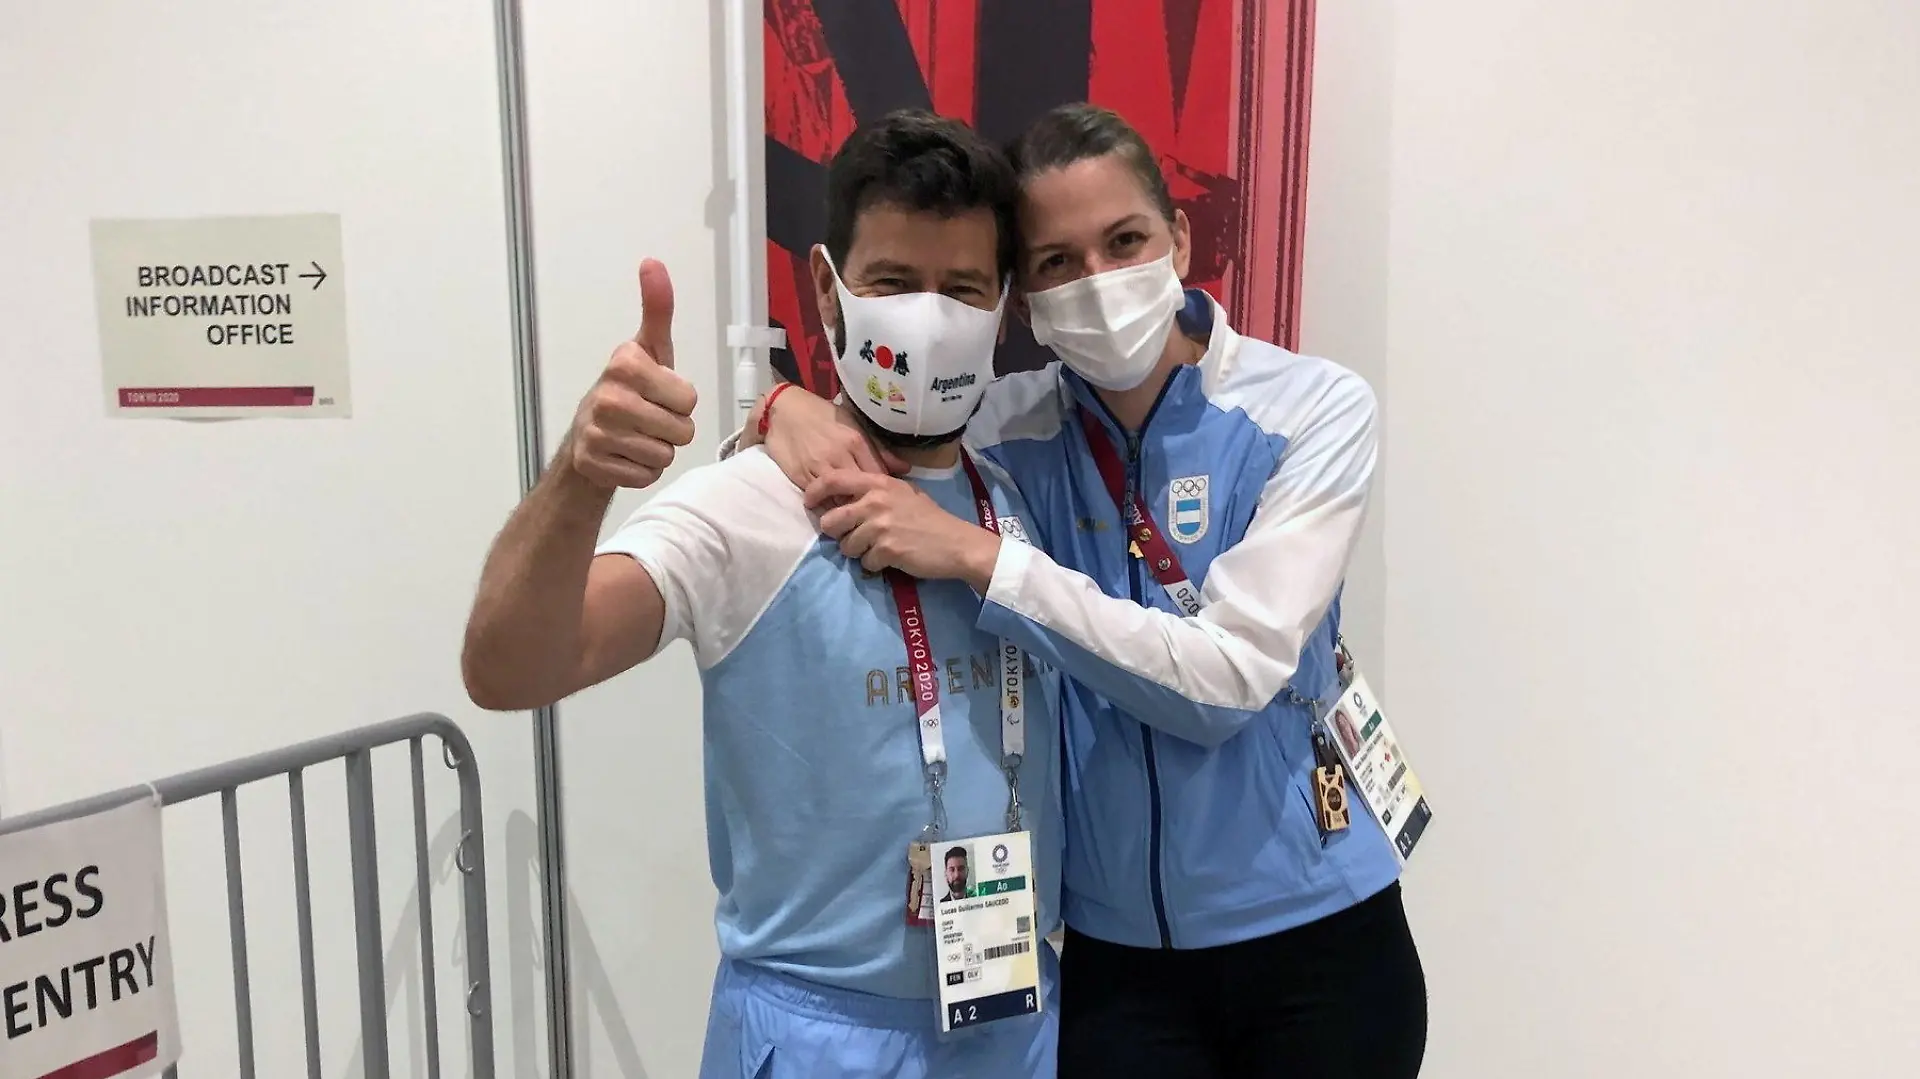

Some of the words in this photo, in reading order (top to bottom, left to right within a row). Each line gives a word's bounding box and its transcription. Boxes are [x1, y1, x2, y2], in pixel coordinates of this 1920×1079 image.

[138, 263, 289, 287] BROADCAST
[126, 294, 292, 317] INFORMATION
[207, 324, 294, 345] OFFICE
[127, 392, 157, 403] TOKYO
[158, 391, 179, 403] 2020
[930, 372, 976, 394] Argentina
[981, 499, 995, 531] Atos
[1176, 587, 1201, 617] 020
[905, 606, 926, 659] TOKYO
[916, 662, 934, 701] 2020
[1005, 644, 1018, 697] TOKYO
[3, 935, 155, 1039] ENTRY
[953, 1011, 963, 1024] A
[968, 1006, 977, 1020] 2
[1026, 993, 1034, 1008] R
